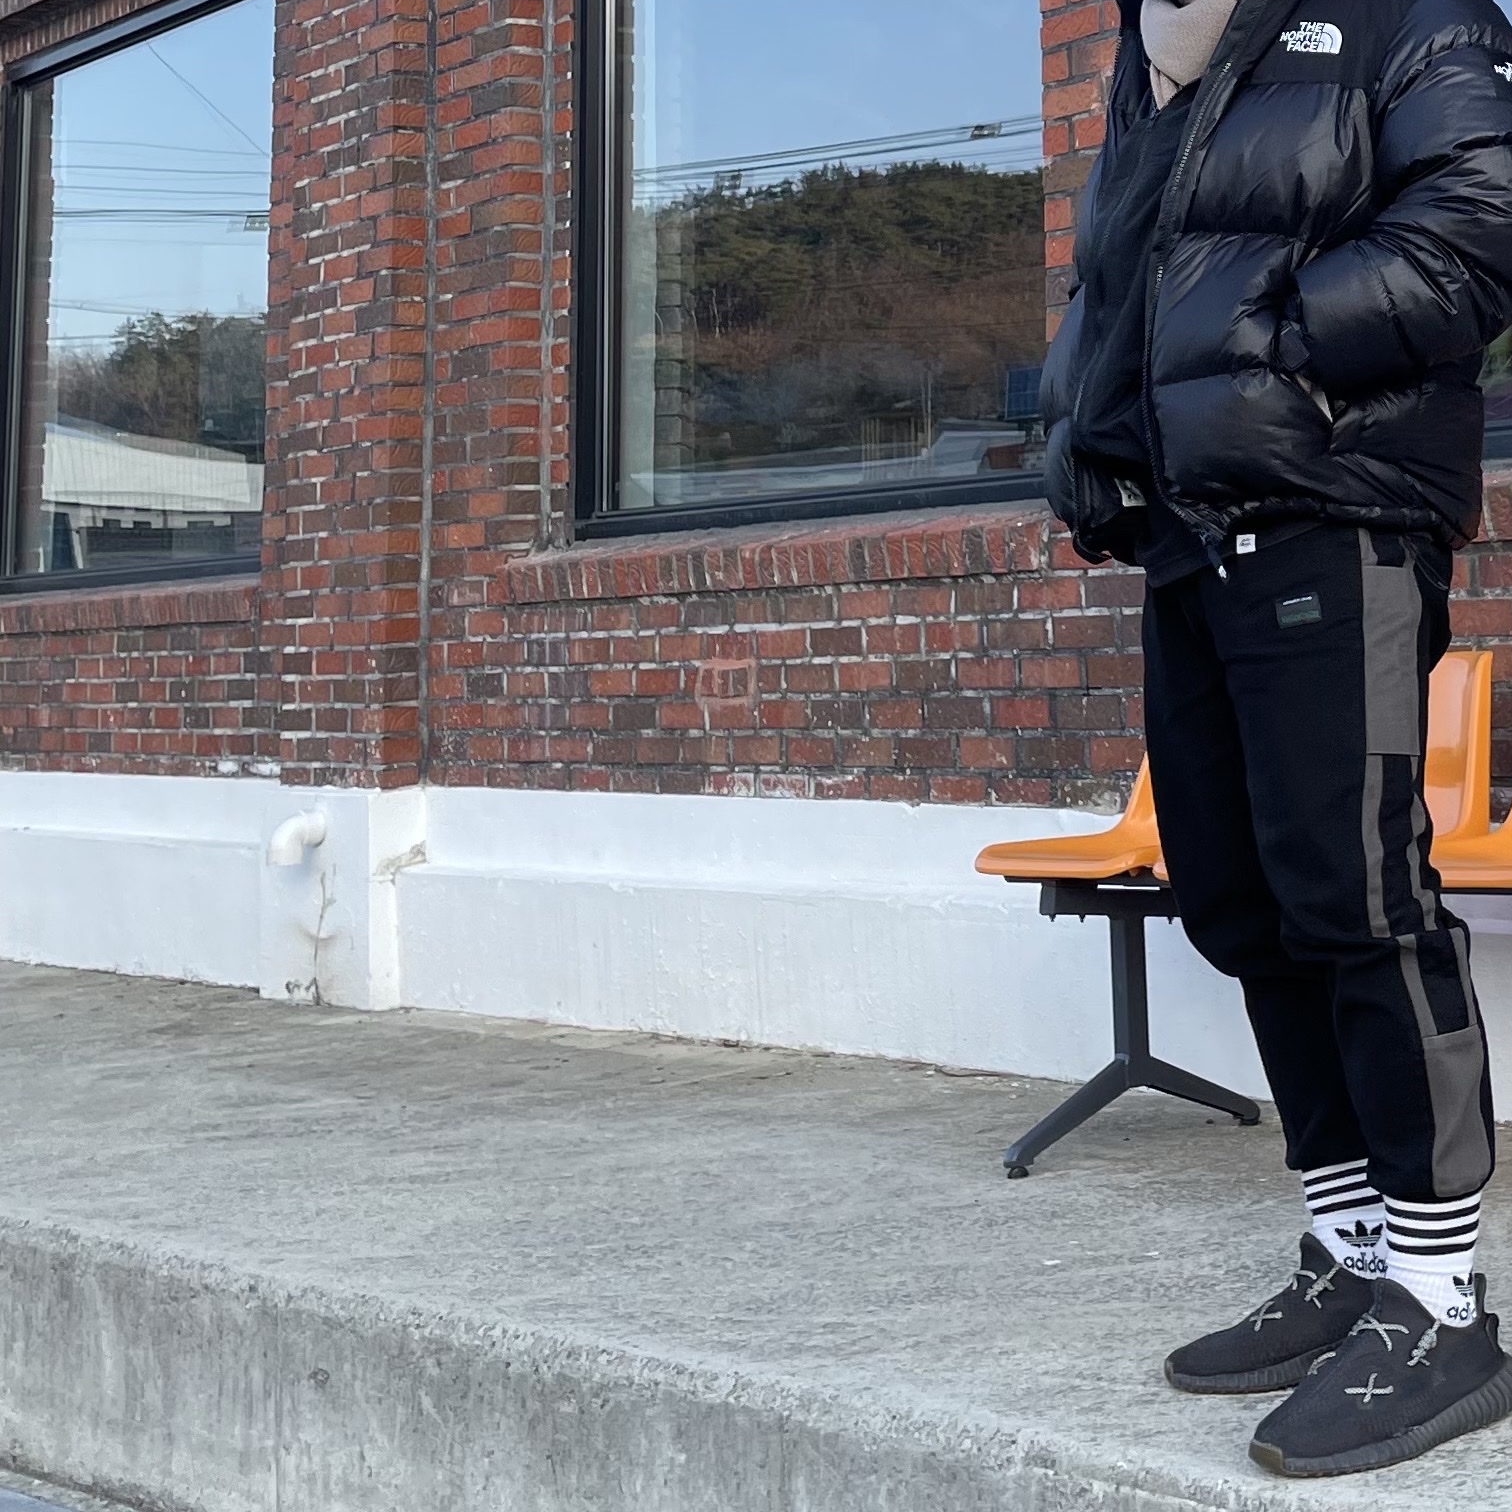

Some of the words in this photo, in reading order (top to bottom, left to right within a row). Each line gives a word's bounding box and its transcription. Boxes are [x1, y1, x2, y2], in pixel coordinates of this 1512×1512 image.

[1299, 21, 1325, 33] THE
[1279, 30, 1321, 42] NORTH
[1286, 40, 1319, 53] FACE
